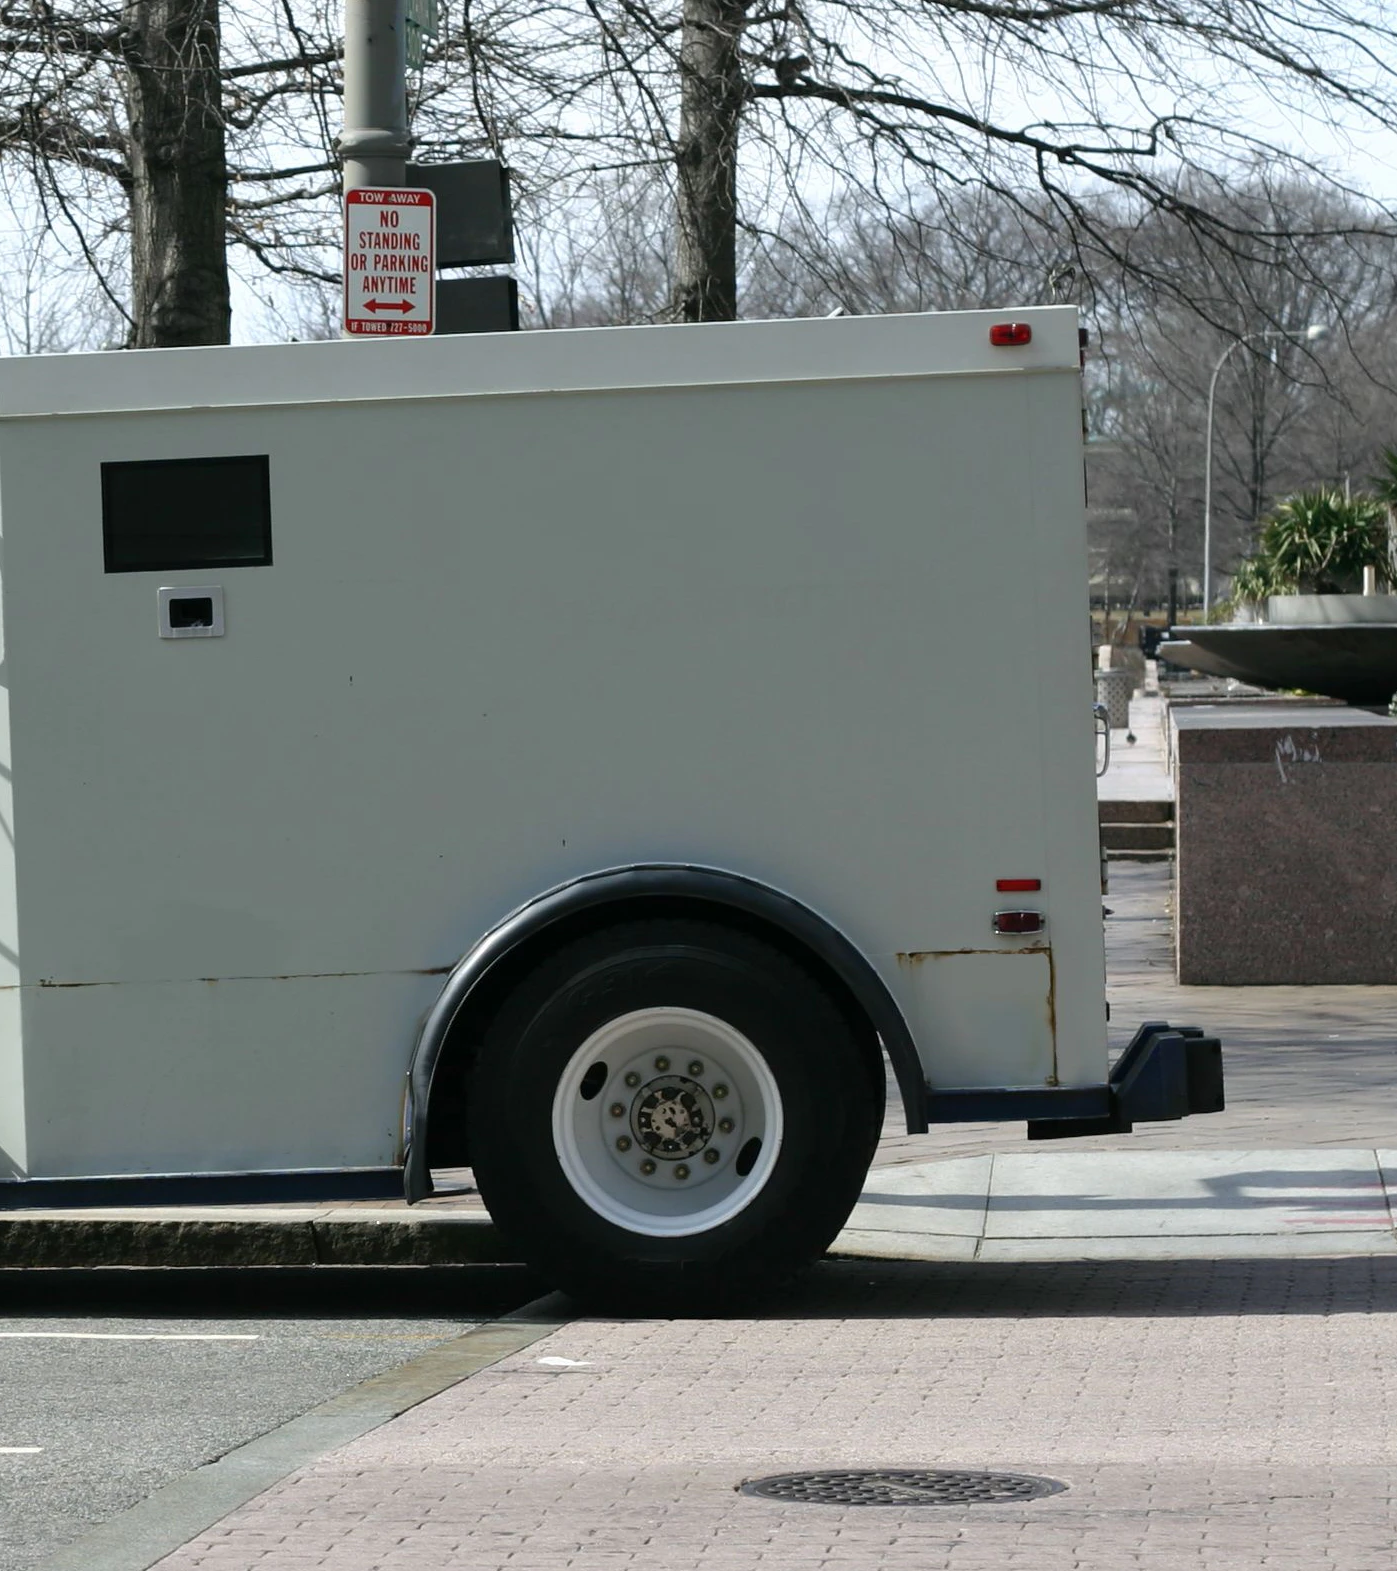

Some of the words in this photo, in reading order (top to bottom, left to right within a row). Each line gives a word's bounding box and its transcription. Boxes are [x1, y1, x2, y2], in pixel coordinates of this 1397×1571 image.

[359, 191, 385, 203] TOW
[389, 193, 421, 204] AWAY
[380, 210, 399, 228] NO
[359, 231, 420, 251] STANDING
[351, 253, 367, 271] OR
[374, 254, 428, 273] PARKING
[363, 275, 416, 294] ANYTIME
[351, 321, 358, 332] IF
[361, 321, 387, 332] TOWED
